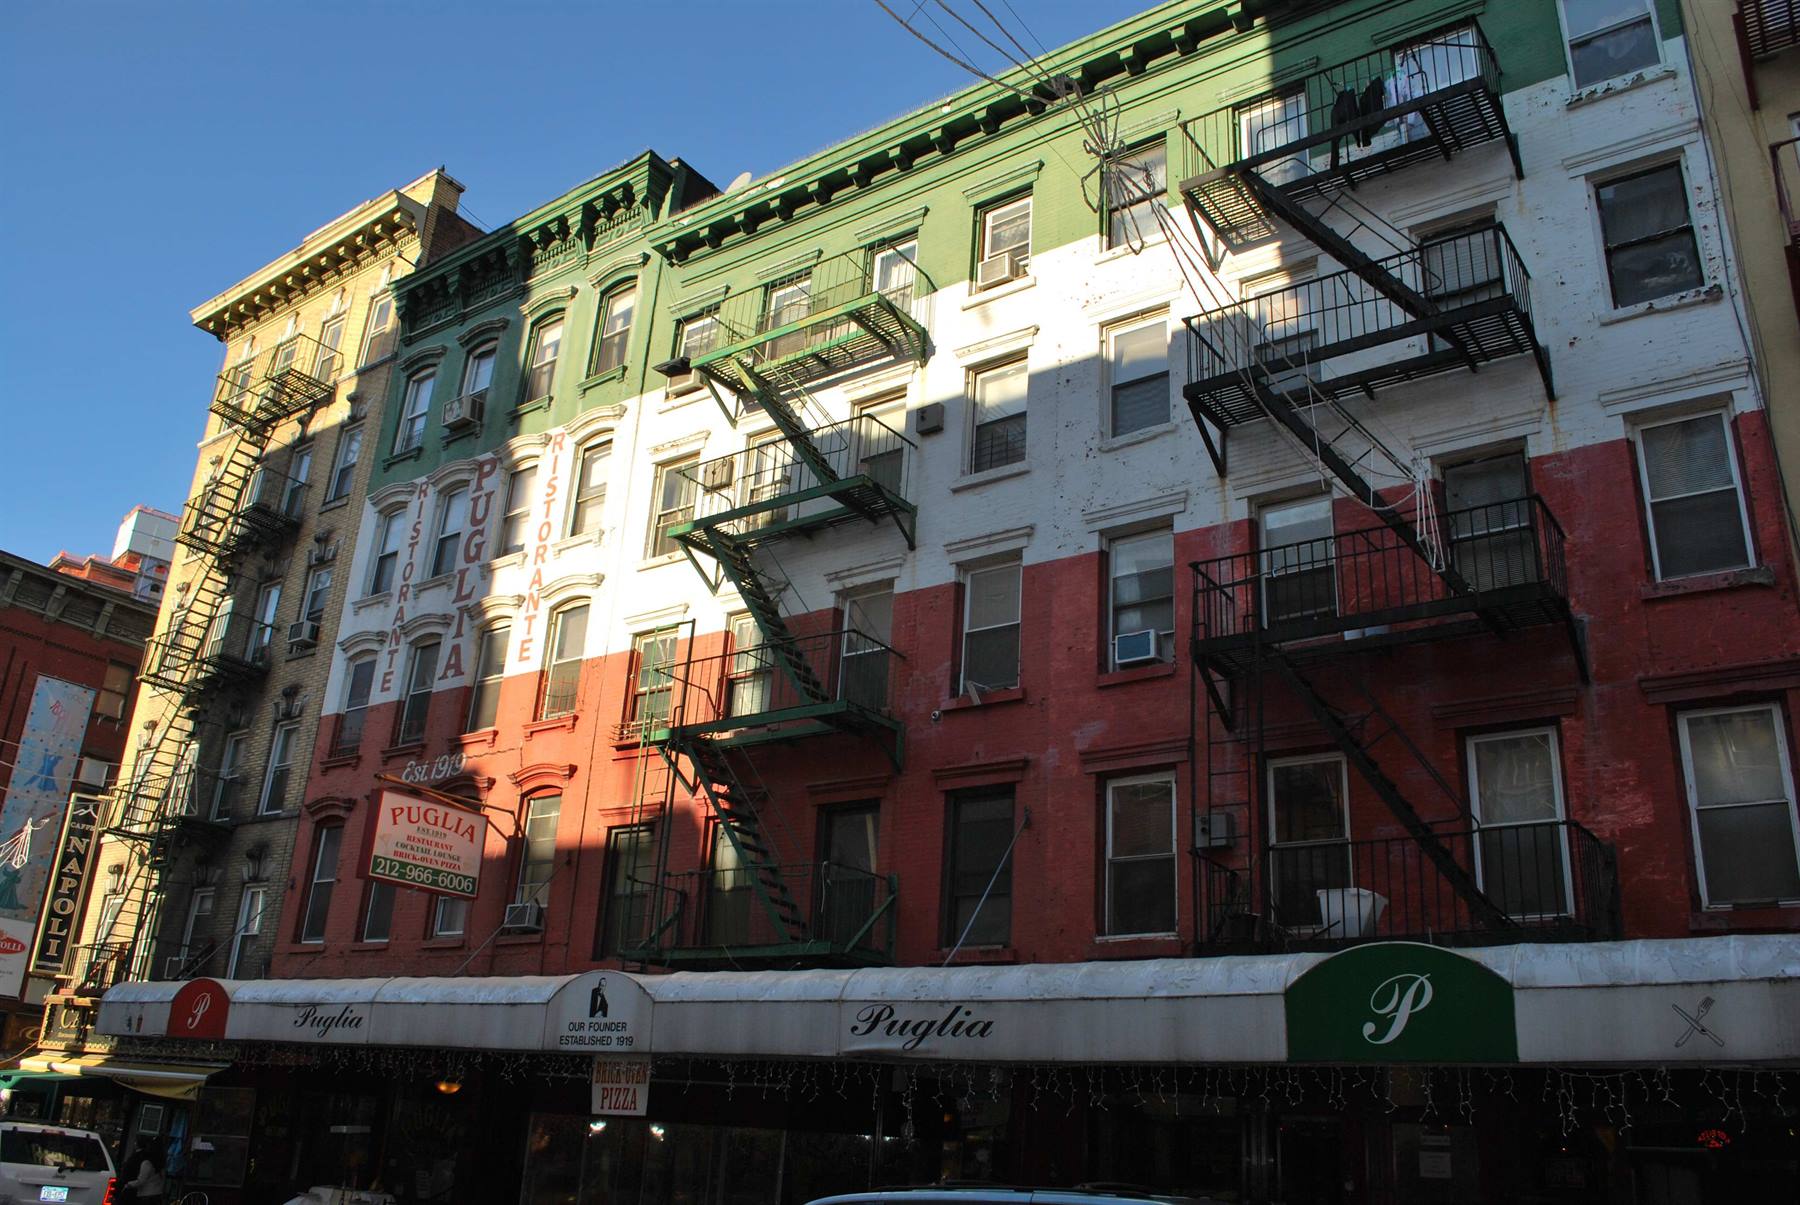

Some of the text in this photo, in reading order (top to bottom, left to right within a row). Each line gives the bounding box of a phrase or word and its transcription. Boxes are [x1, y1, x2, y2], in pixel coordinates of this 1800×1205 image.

[517, 432, 565, 662] RISTORANTE
[438, 457, 497, 680] PUGLIA
[380, 483, 430, 693] RISTORANTE
[391, 806, 475, 844] PUGLIA
[406, 834, 454, 851] RESTAURANT
[393, 850, 461, 871] BRICK-OVEN PIZZA
[395, 841, 461, 862] COCKTAIL LOUNGE
[375, 858, 473, 893] 212-966-6006
[45, 836, 90, 956] NAPOLI
[187, 992, 211, 1030] P
[293, 1003, 364, 1038] Puglia
[850, 1003, 994, 1050] Puglia
[1362, 973, 1433, 1044] P
[559, 1035, 634, 1047] ESTABLISHED 1919
[568, 1022, 627, 1032] OUR FOUNDER
[600, 1087, 637, 1111] PIZZA
